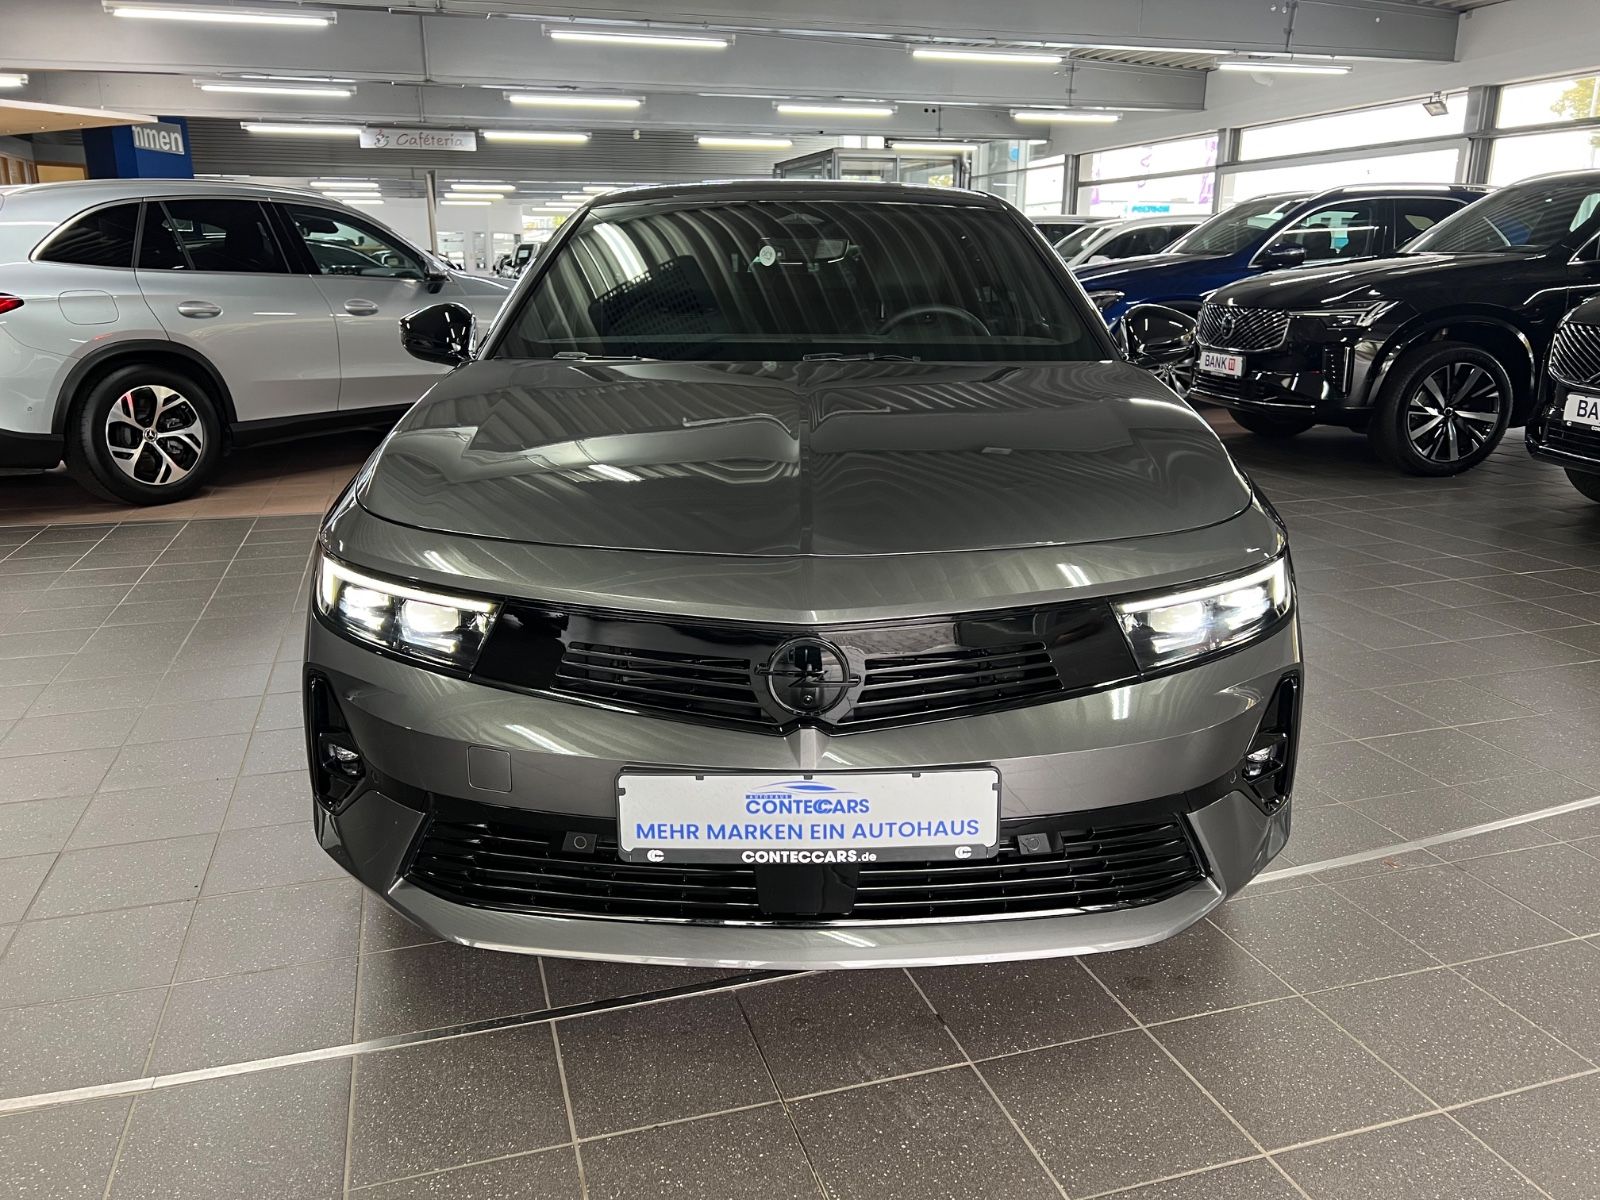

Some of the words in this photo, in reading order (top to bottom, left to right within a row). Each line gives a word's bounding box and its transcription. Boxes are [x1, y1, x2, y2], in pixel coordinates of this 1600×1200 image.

[396, 132, 463, 147] Caféteria
[1204, 354, 1228, 370] BANK
[636, 823, 700, 840] MEHR
[707, 824, 803, 840] MARKEN
[810, 824, 845, 840] EIN
[852, 819, 980, 839] AUTOHAUS
[741, 850, 877, 864] CONTECCARS.de
